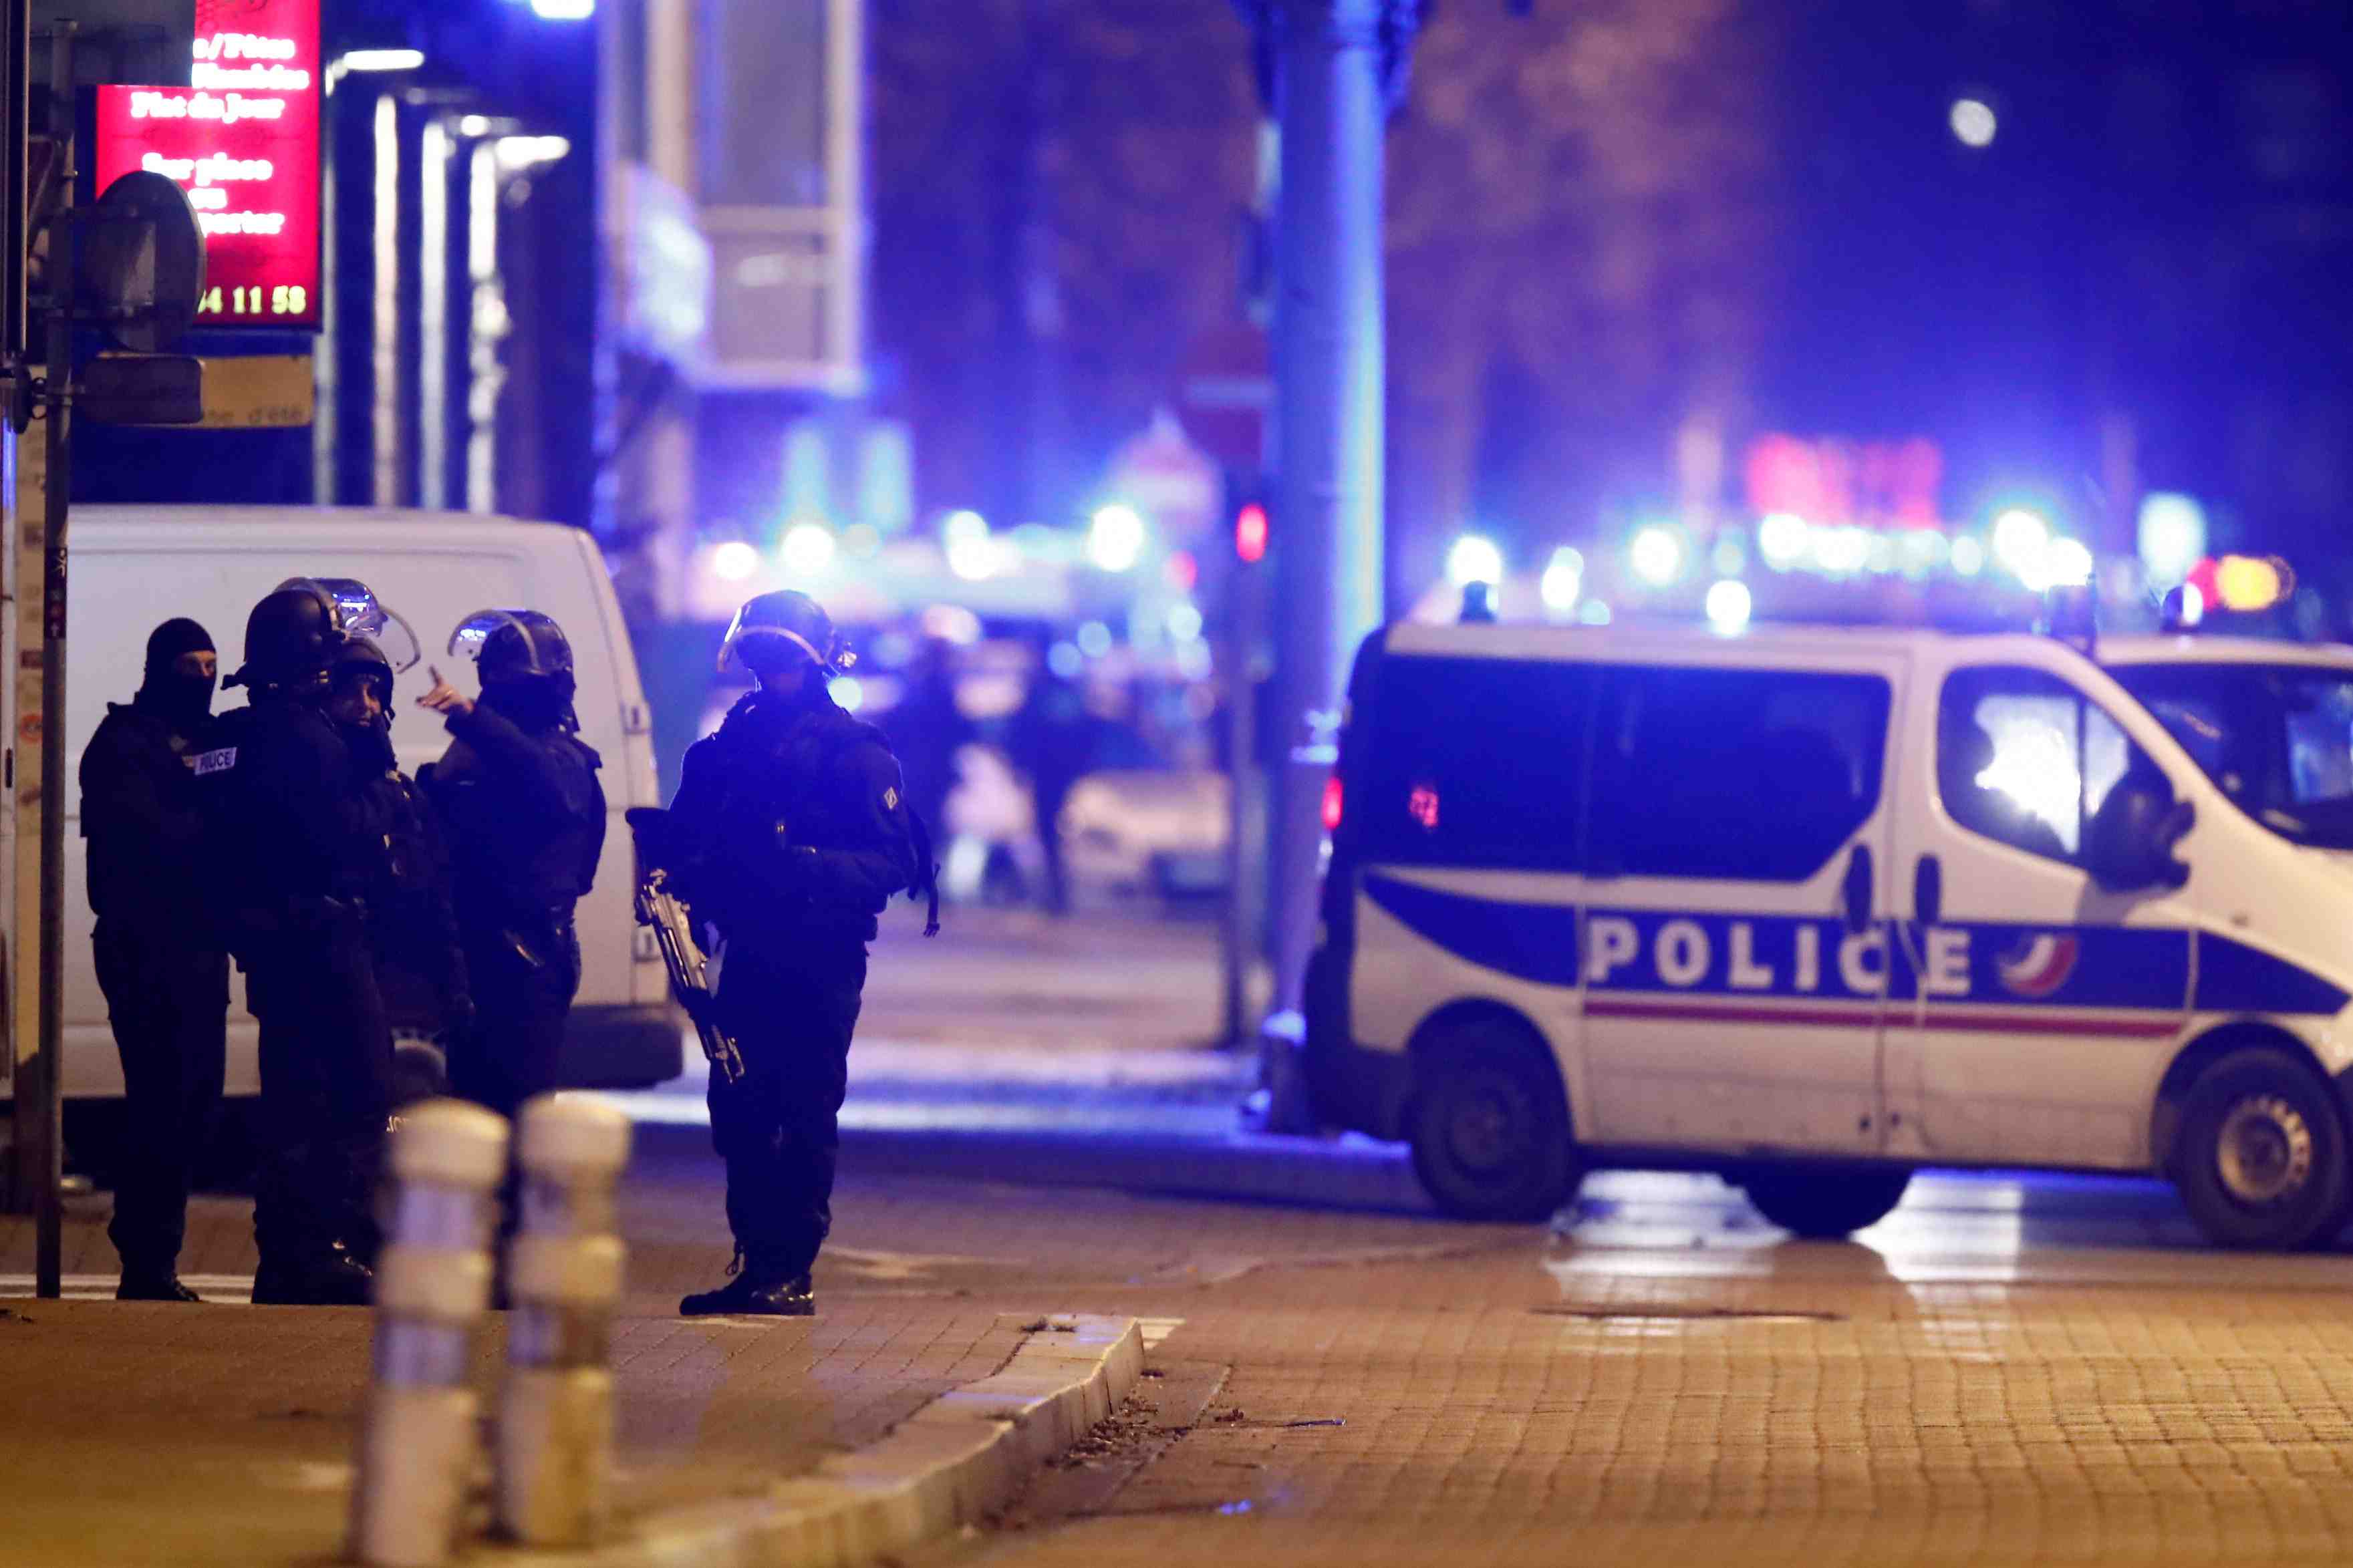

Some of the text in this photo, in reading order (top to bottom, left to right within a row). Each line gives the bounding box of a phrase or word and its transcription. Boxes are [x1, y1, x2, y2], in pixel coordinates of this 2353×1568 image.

[131, 92, 286, 124] Plat du jour
[195, 152, 274, 187] place
[200, 750, 232, 771] POLICE
[1587, 917, 1971, 995] POLICE
